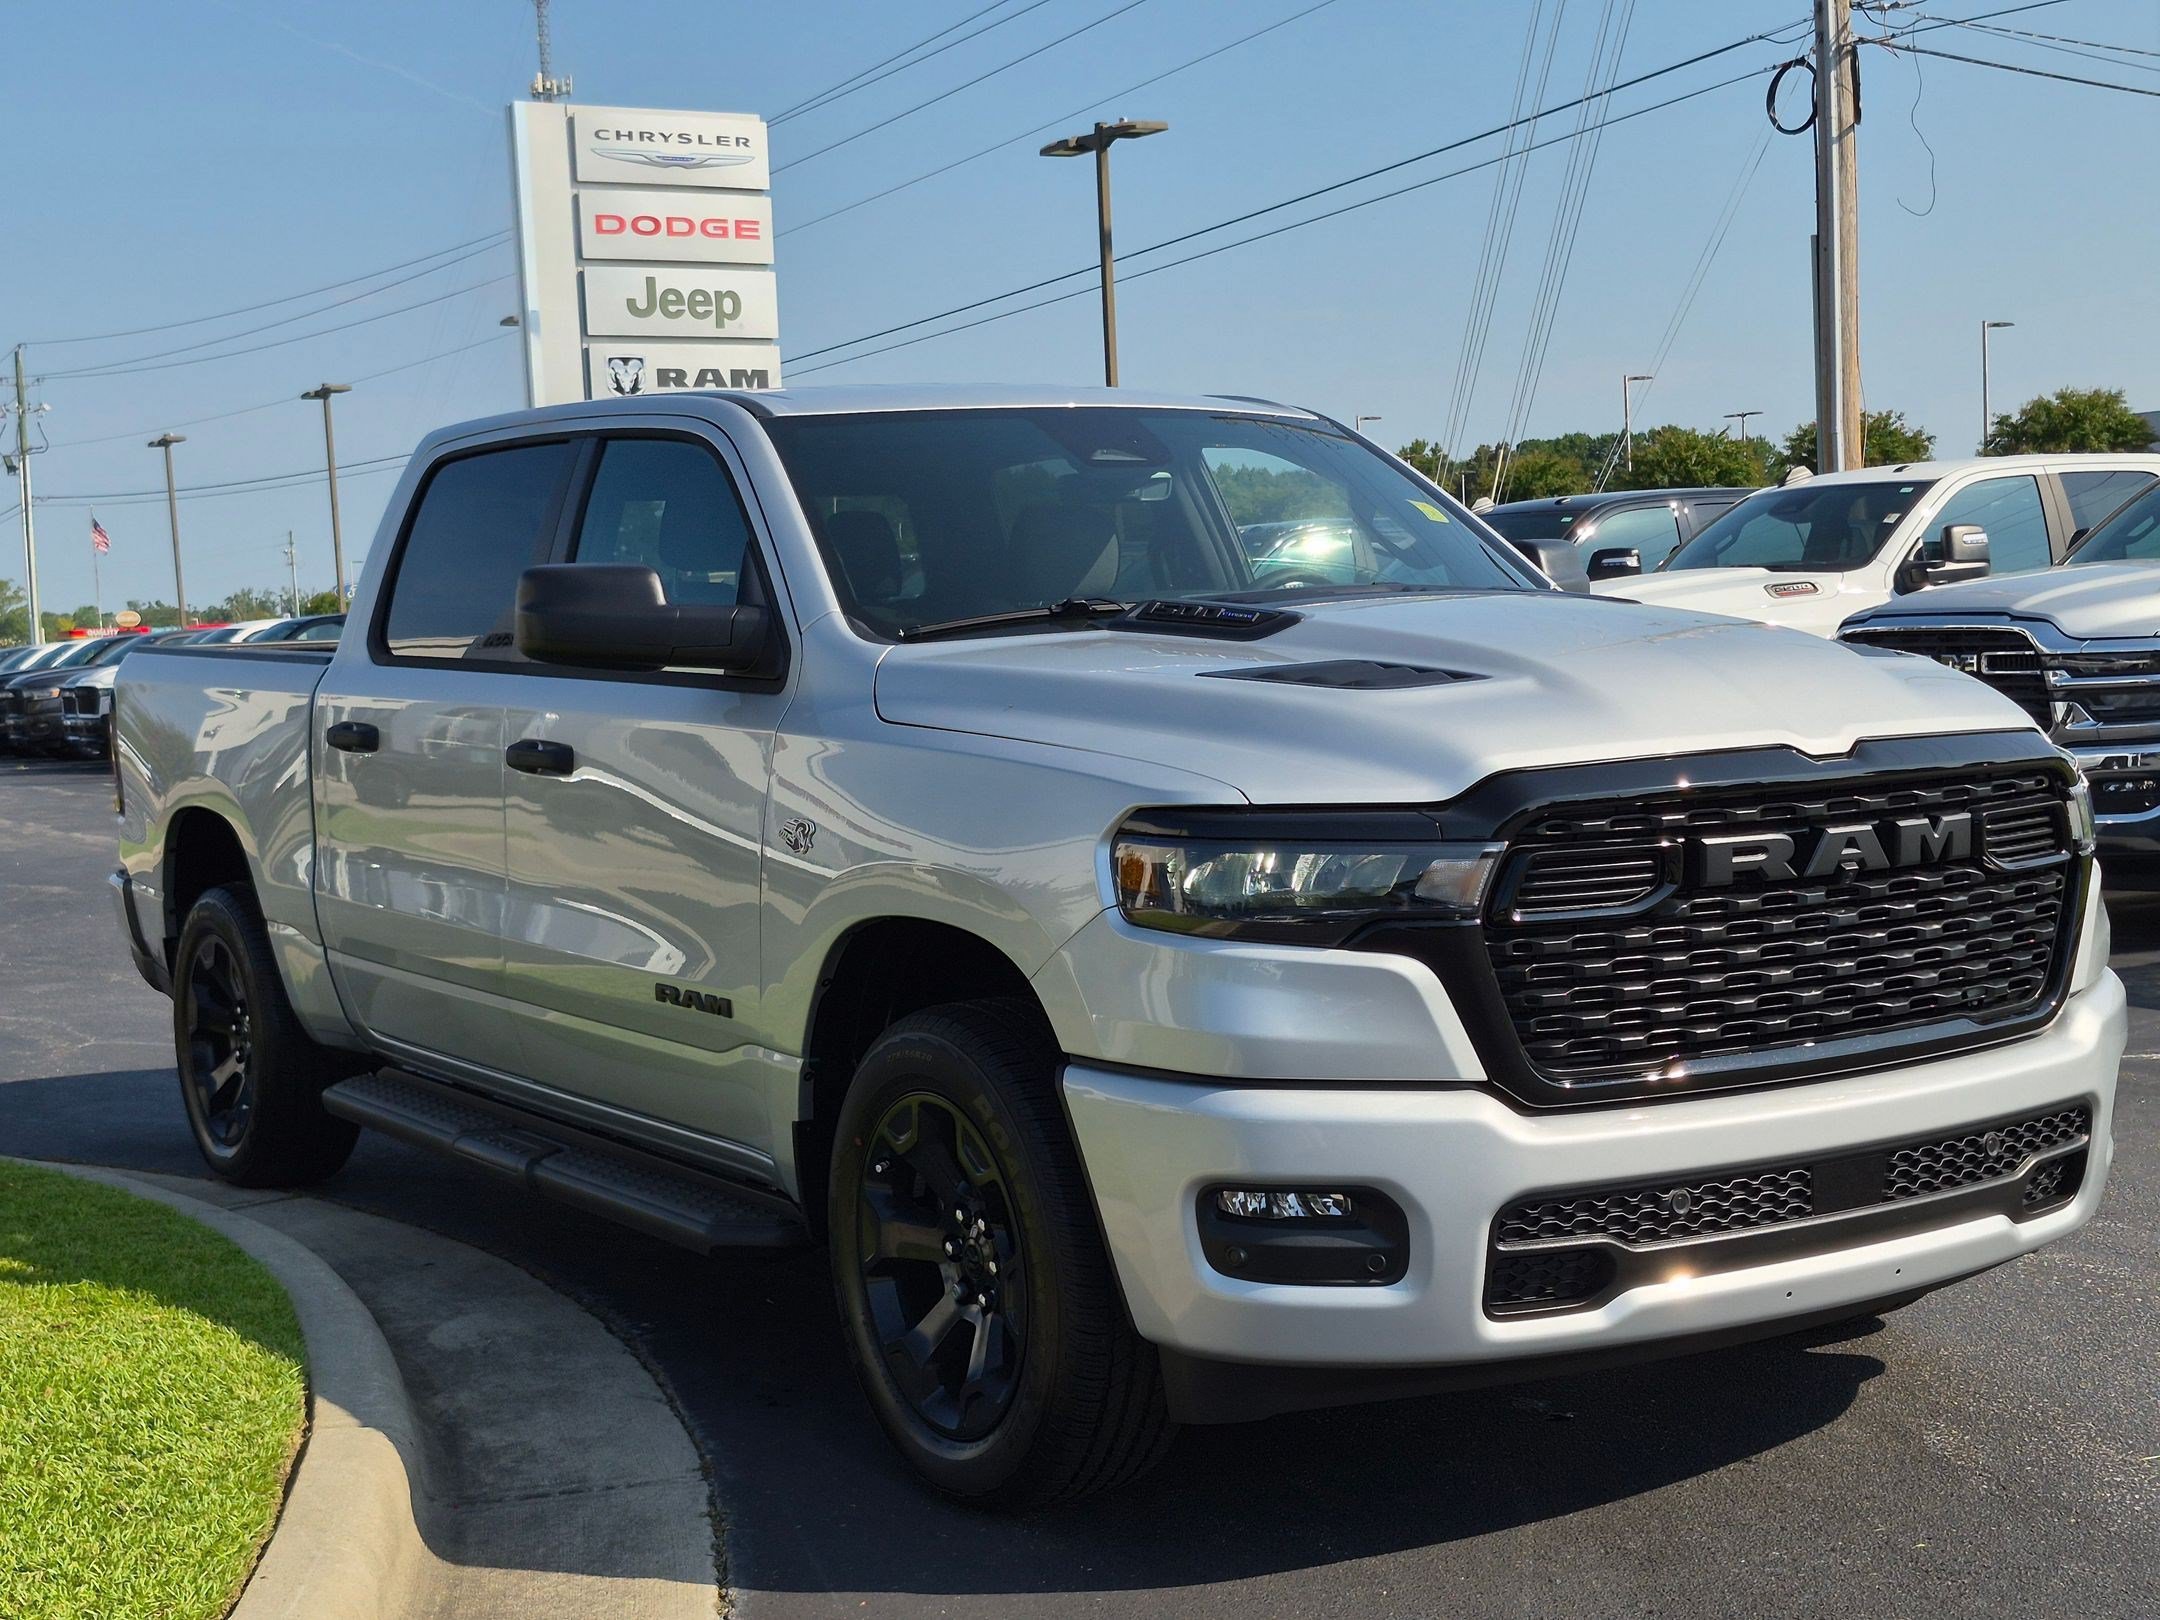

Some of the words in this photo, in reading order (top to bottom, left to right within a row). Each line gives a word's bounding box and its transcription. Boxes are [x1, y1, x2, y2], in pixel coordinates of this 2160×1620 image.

[594, 129, 751, 148] CHRYSLER
[595, 214, 761, 240] DODGE
[626, 276, 742, 329] Jeep
[656, 368, 769, 388] RAM
[1701, 812, 1971, 887] RAM
[655, 983, 733, 1018] RAM
